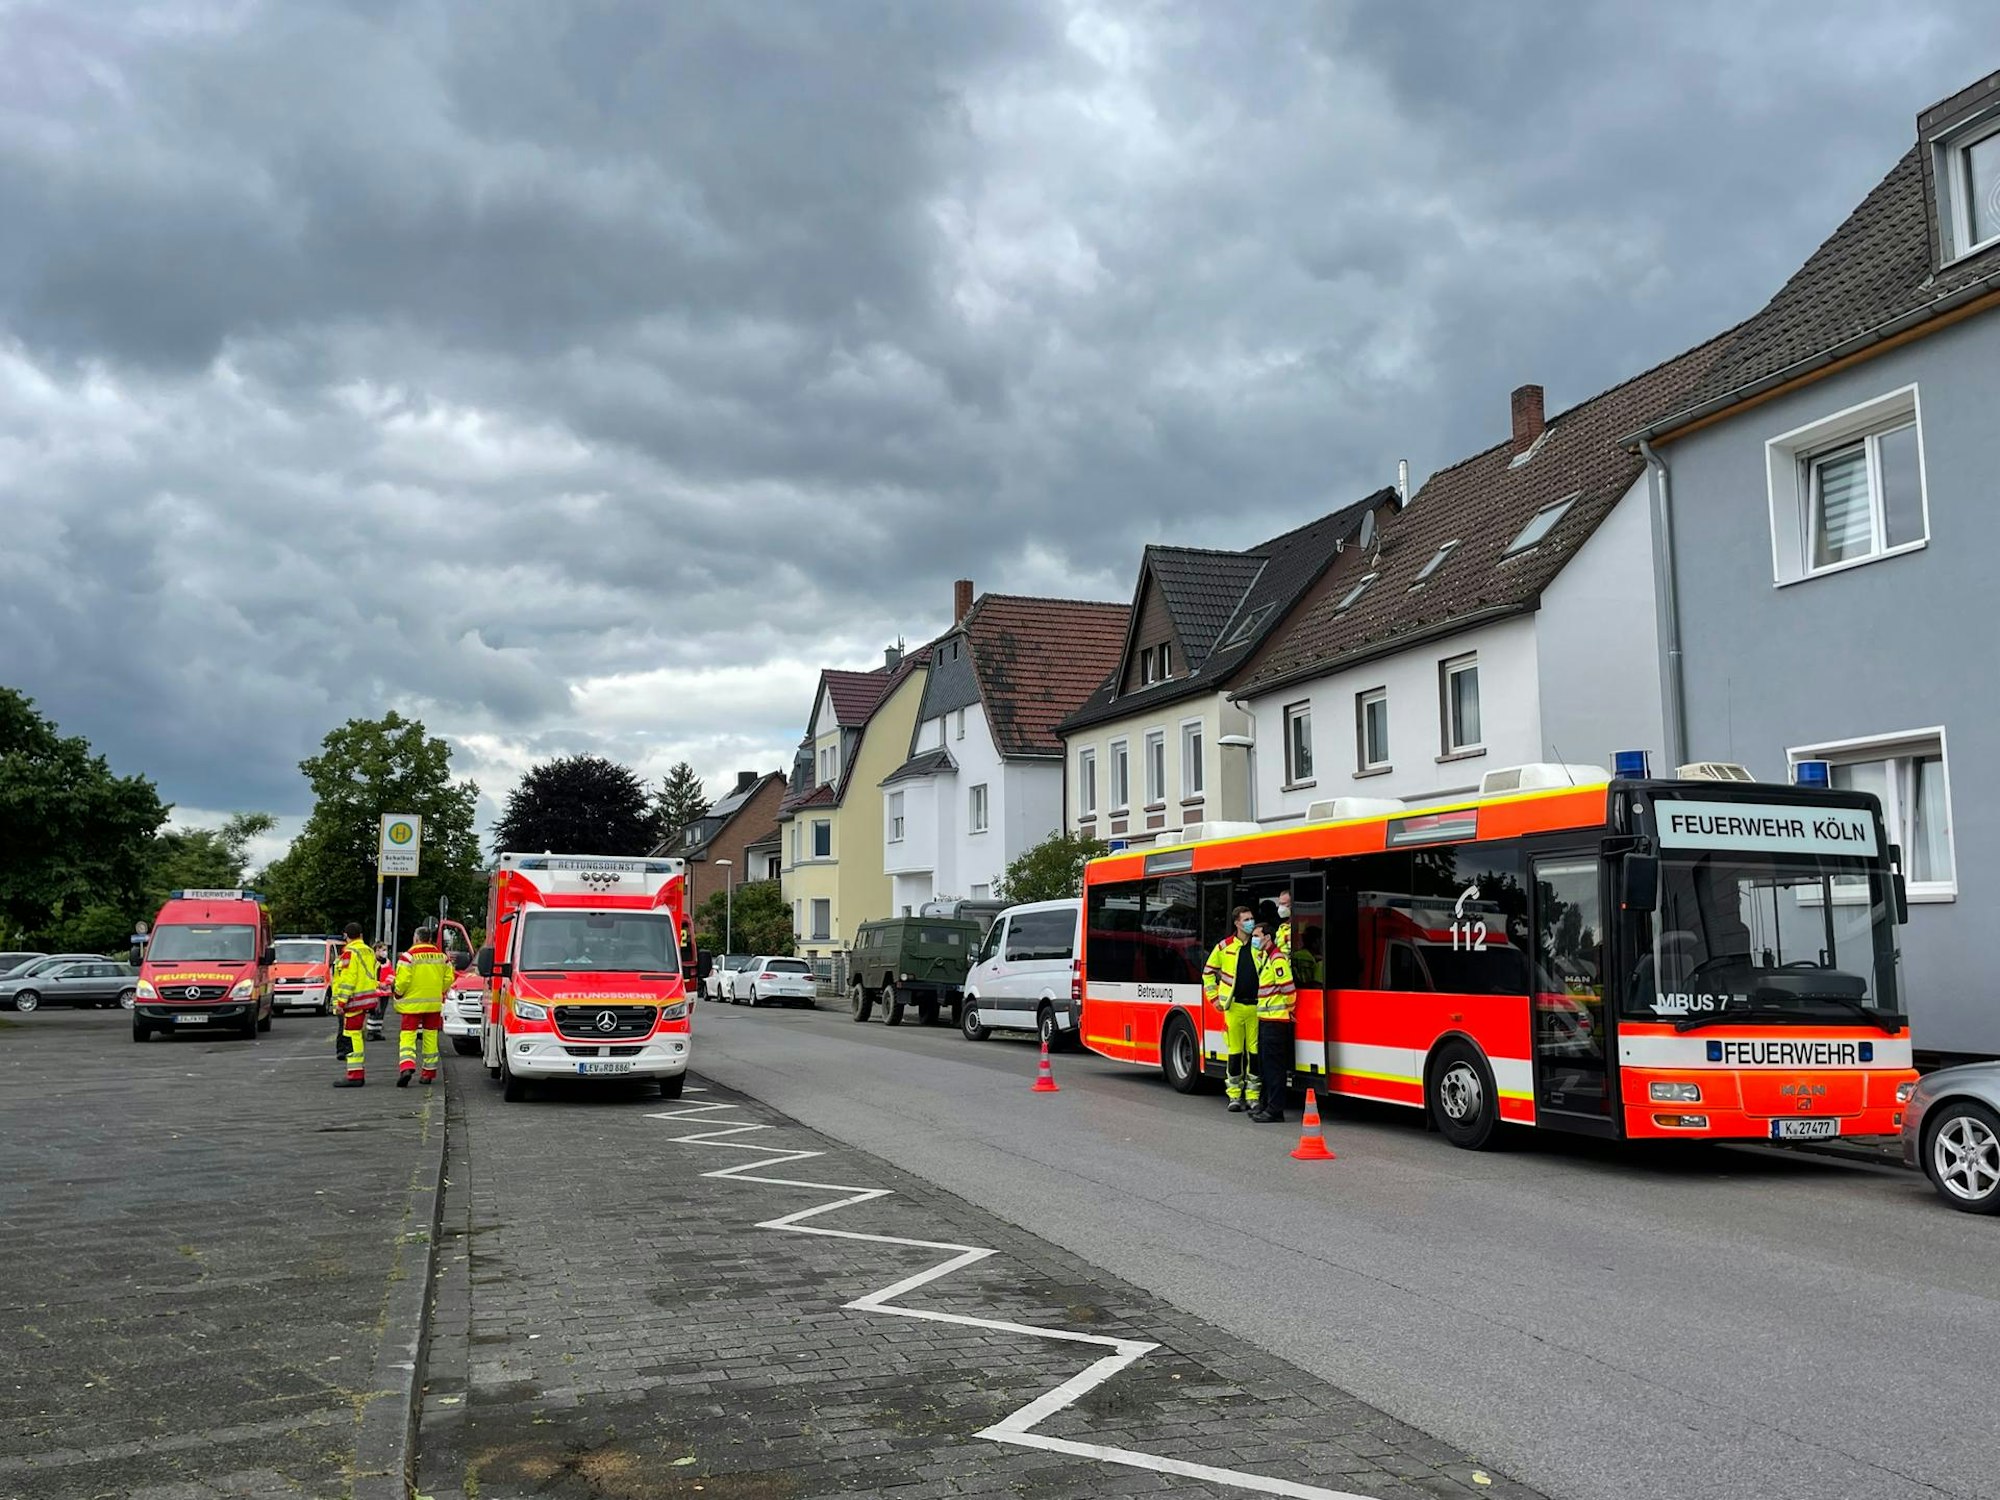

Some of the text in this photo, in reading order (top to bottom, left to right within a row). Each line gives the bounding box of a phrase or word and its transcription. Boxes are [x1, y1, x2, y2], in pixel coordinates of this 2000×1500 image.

[395, 826, 406, 840] H
[1672, 815, 1866, 842] FEUERWEHR KÖLN
[557, 861, 635, 872] RETTUNGSDIENST
[191, 890, 236, 899] FEUERWEHR
[1449, 921, 1488, 951] 112
[154, 973, 234, 982] FEUERWEHR
[1564, 975, 1591, 983] MAN
[553, 992, 657, 1000] RETTUNGSDIENST
[1137, 984, 1174, 1003] Betreuung
[1656, 993, 1729, 1012] MBUS 7
[1724, 1042, 1856, 1066] FEUERWEHR
[1781, 1085, 1826, 1096] MAN
[1799, 1121, 1831, 1135] 27477
